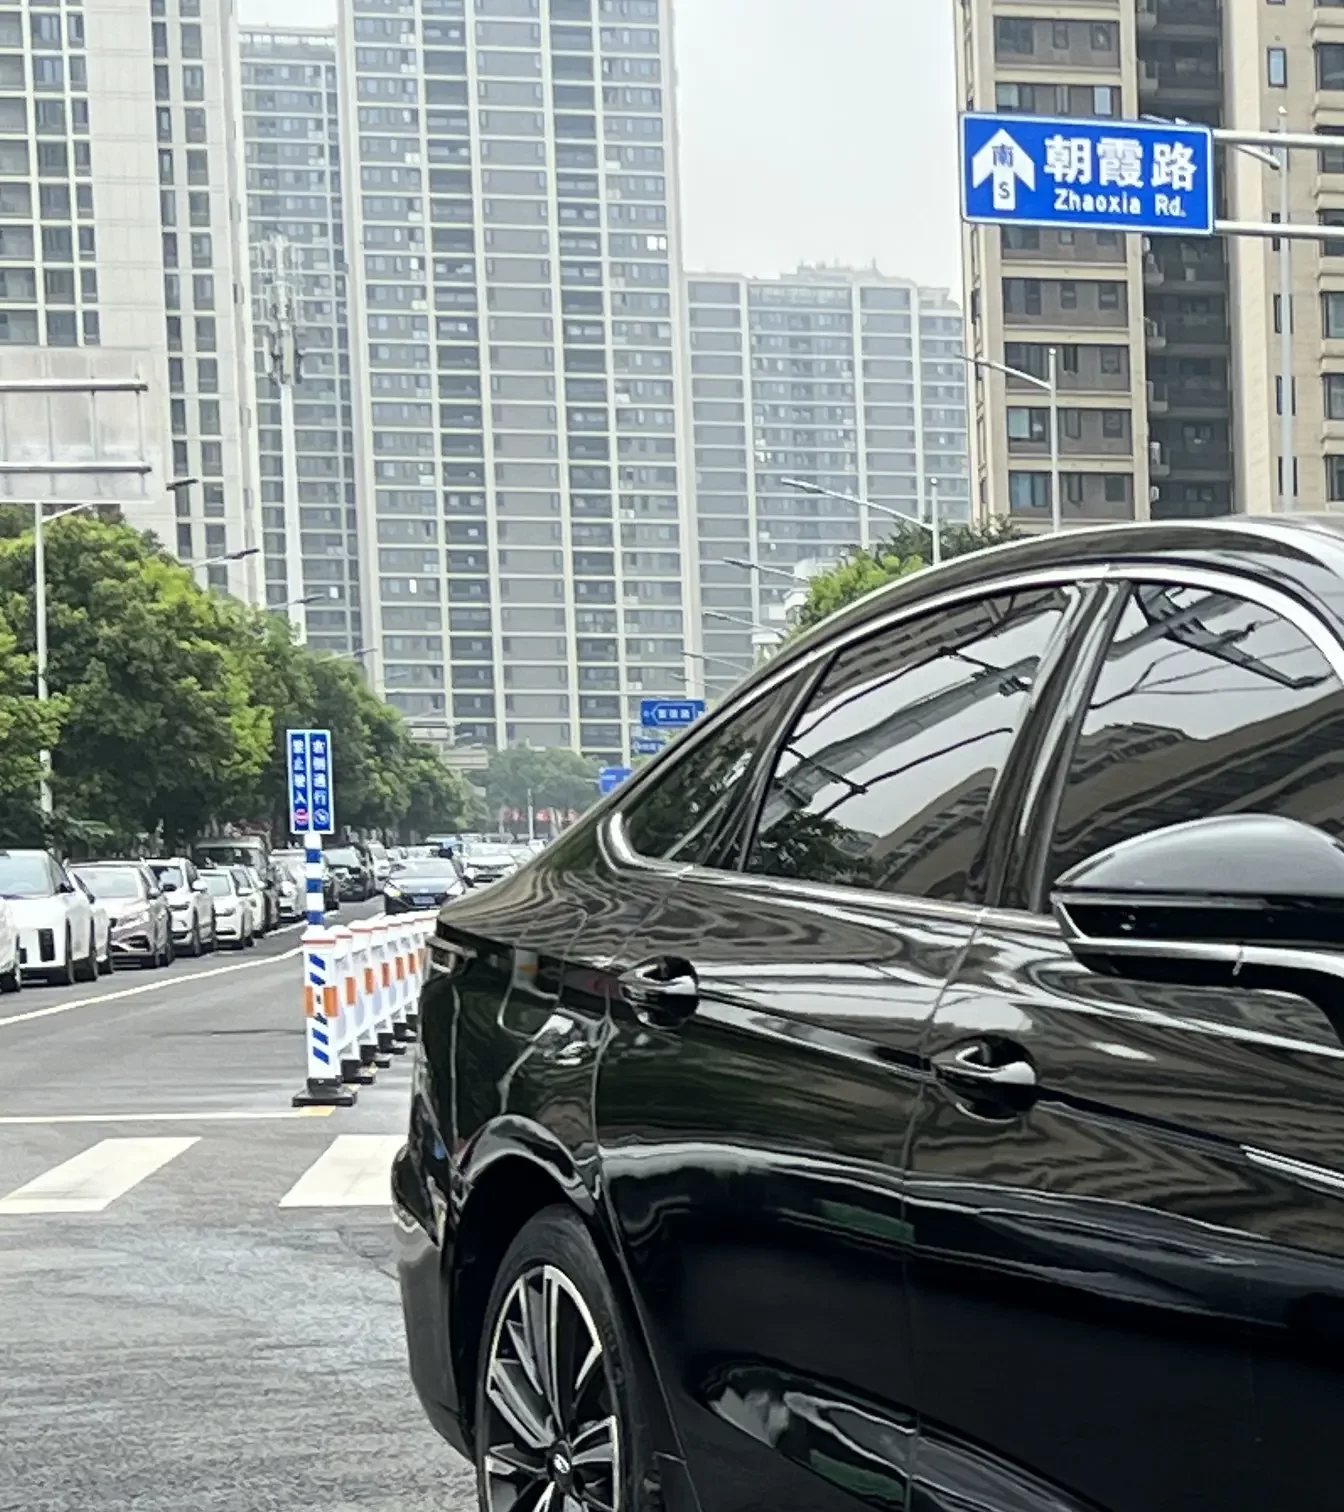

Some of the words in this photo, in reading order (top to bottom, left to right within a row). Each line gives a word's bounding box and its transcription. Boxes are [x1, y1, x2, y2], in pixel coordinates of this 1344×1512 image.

[992, 144, 1014, 167] 南
[1043, 134, 1198, 192] 朝霞路
[998, 181, 1011, 200] S
[1053, 188, 1142, 215] Zhaoxia
